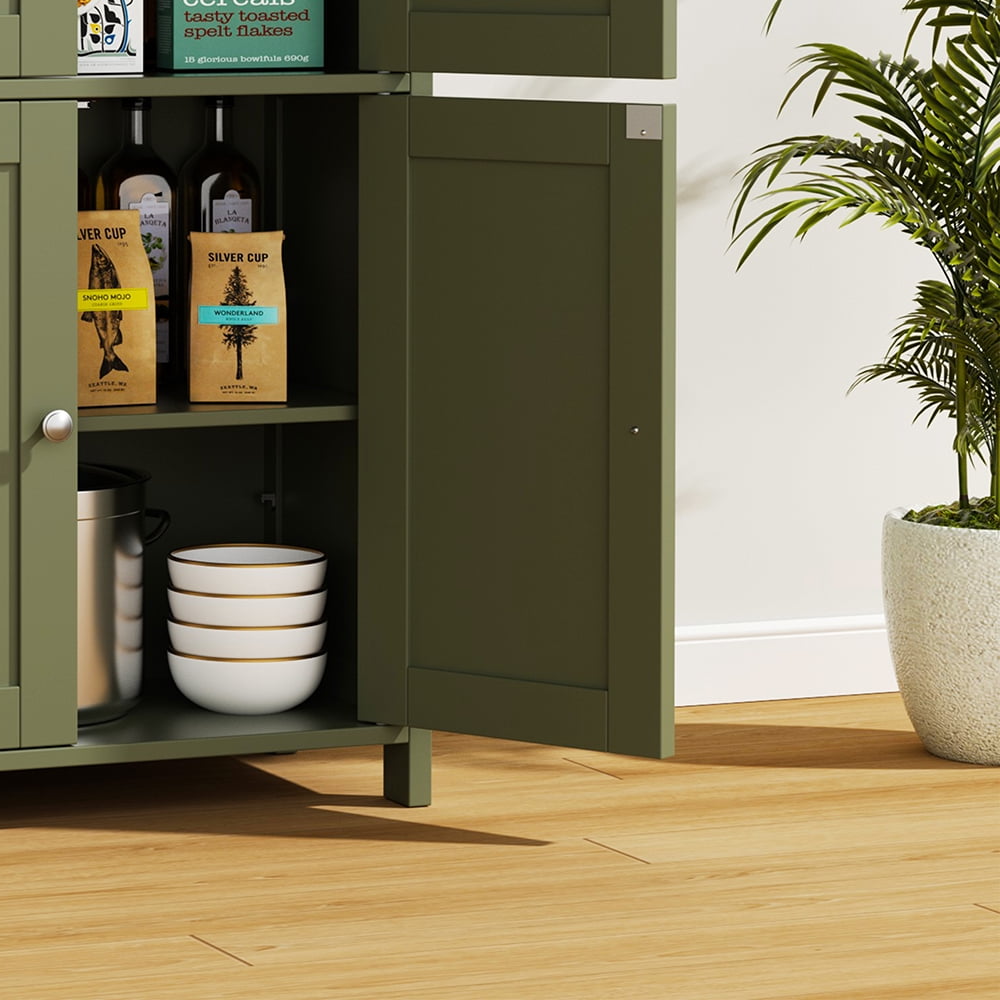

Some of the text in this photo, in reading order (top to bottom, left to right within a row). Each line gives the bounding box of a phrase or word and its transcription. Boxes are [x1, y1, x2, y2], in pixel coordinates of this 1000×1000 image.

[184, 8, 311, 24] tasty toasted
[184, 24, 293, 40] spelt flakes
[197, 56, 238, 64] glorious
[104, 227, 127, 240] CUP
[207, 252, 269, 263] SILVER CUP
